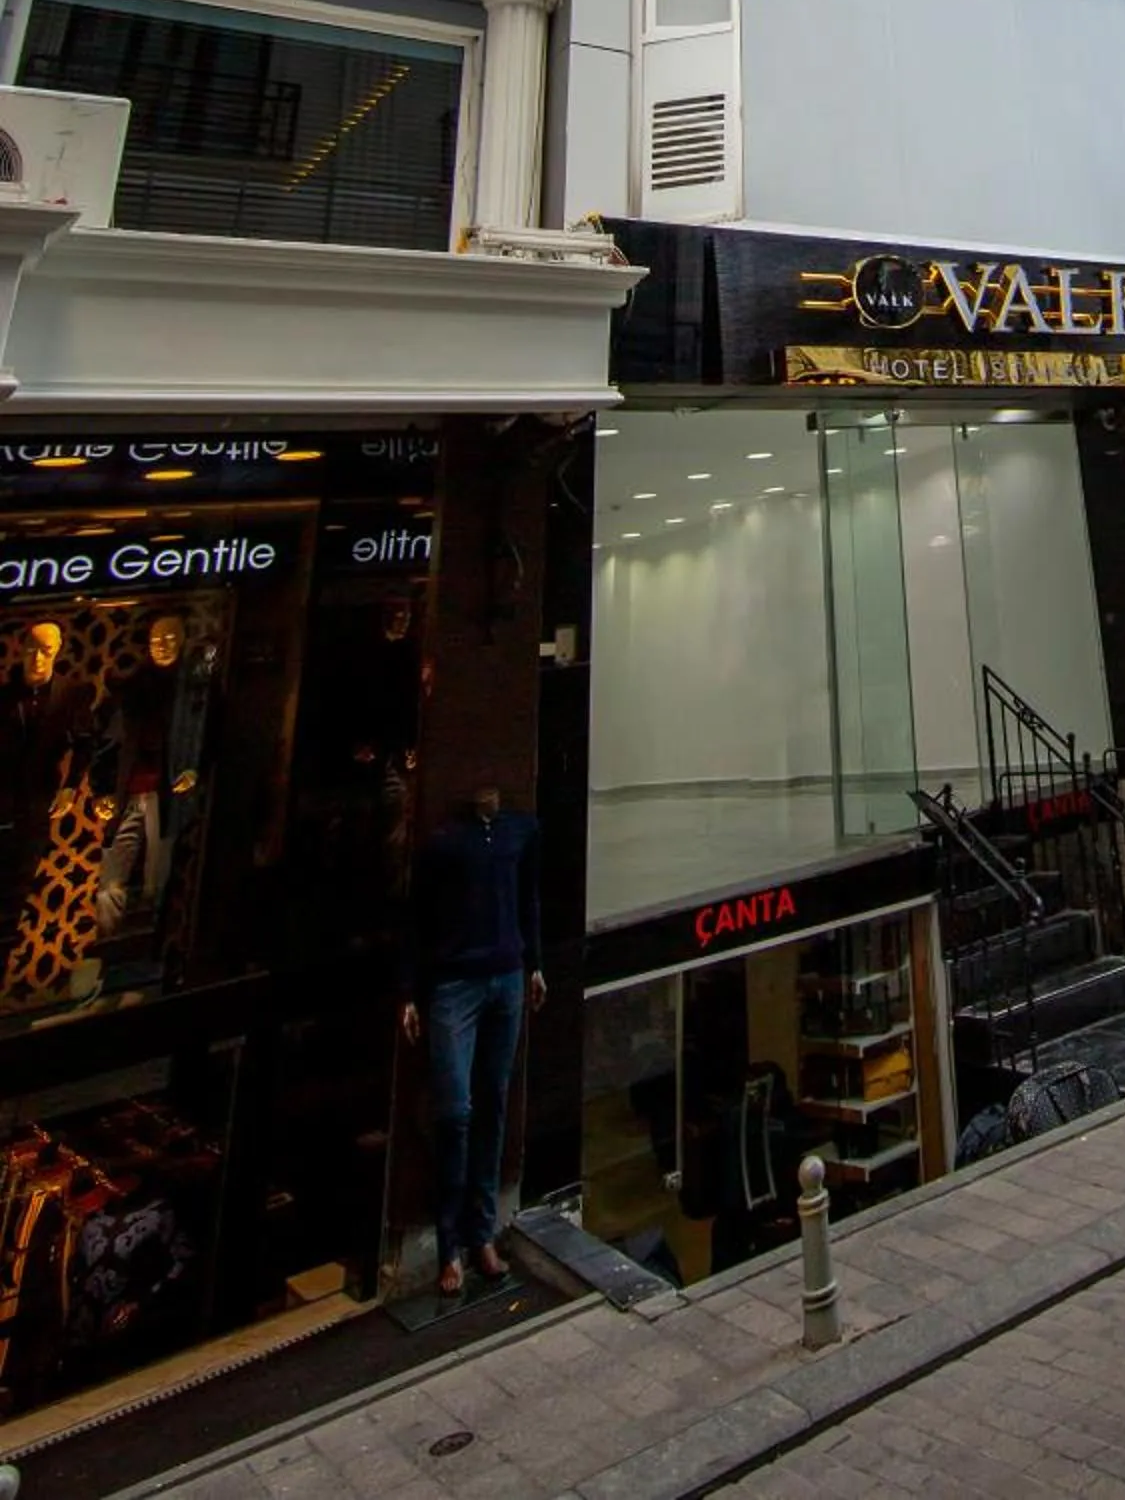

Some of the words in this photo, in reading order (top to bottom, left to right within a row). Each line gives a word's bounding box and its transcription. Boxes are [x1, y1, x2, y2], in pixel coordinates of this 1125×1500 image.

[866, 292, 913, 307] VALK
[869, 353, 965, 380] HOTEL
[110, 538, 276, 580] Gentile
[695, 887, 796, 949] ÇANTA
